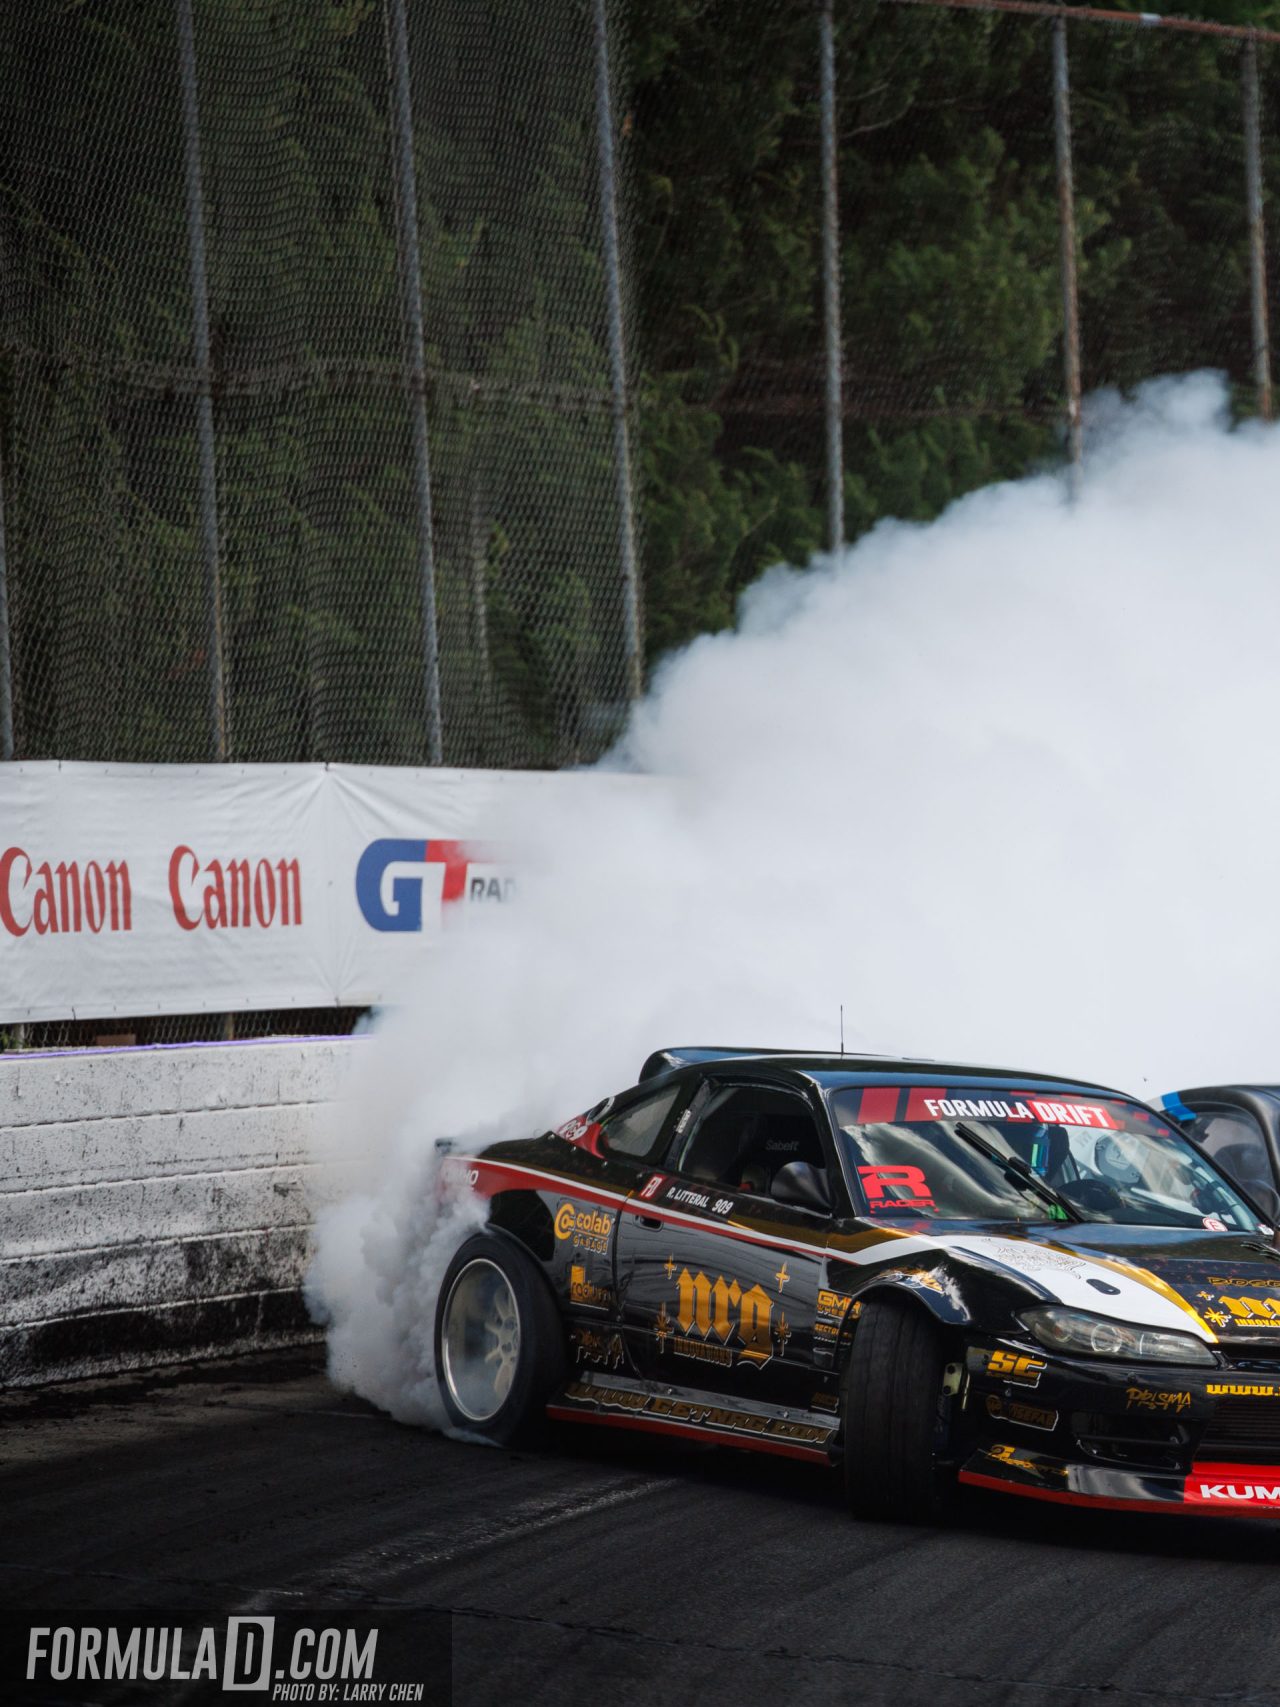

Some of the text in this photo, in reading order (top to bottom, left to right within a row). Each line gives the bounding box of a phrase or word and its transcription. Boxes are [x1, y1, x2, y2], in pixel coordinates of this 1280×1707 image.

[0, 846, 133, 938] Canon
[168, 844, 303, 932] Canon
[924, 1098, 1111, 1128] FORMULA DRIFT
[712, 1198, 735, 1215] 909
[870, 1199, 936, 1209] RACER
[576, 1209, 613, 1236] colab
